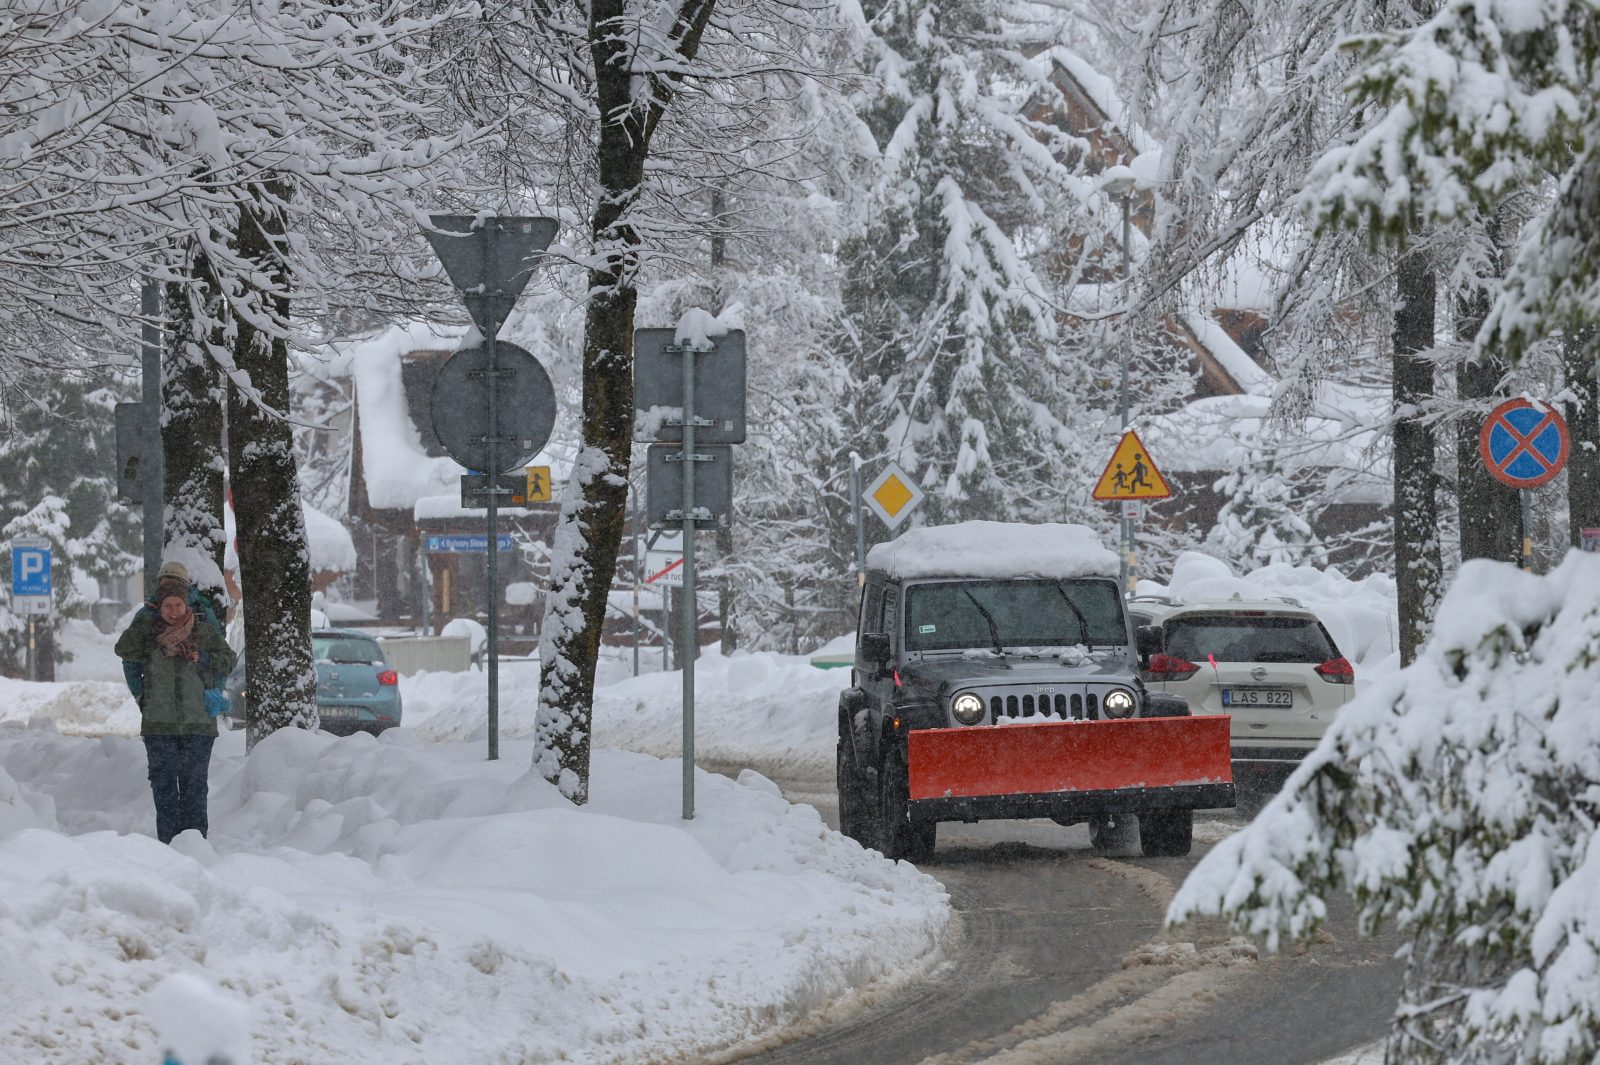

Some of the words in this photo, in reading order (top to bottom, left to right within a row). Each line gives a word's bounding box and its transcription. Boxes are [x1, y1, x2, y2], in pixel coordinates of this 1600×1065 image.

[21, 552, 43, 581] P
[1033, 685, 1055, 694] Jeep
[1231, 691, 1258, 703] LAS
[1267, 692, 1290, 704] 822
